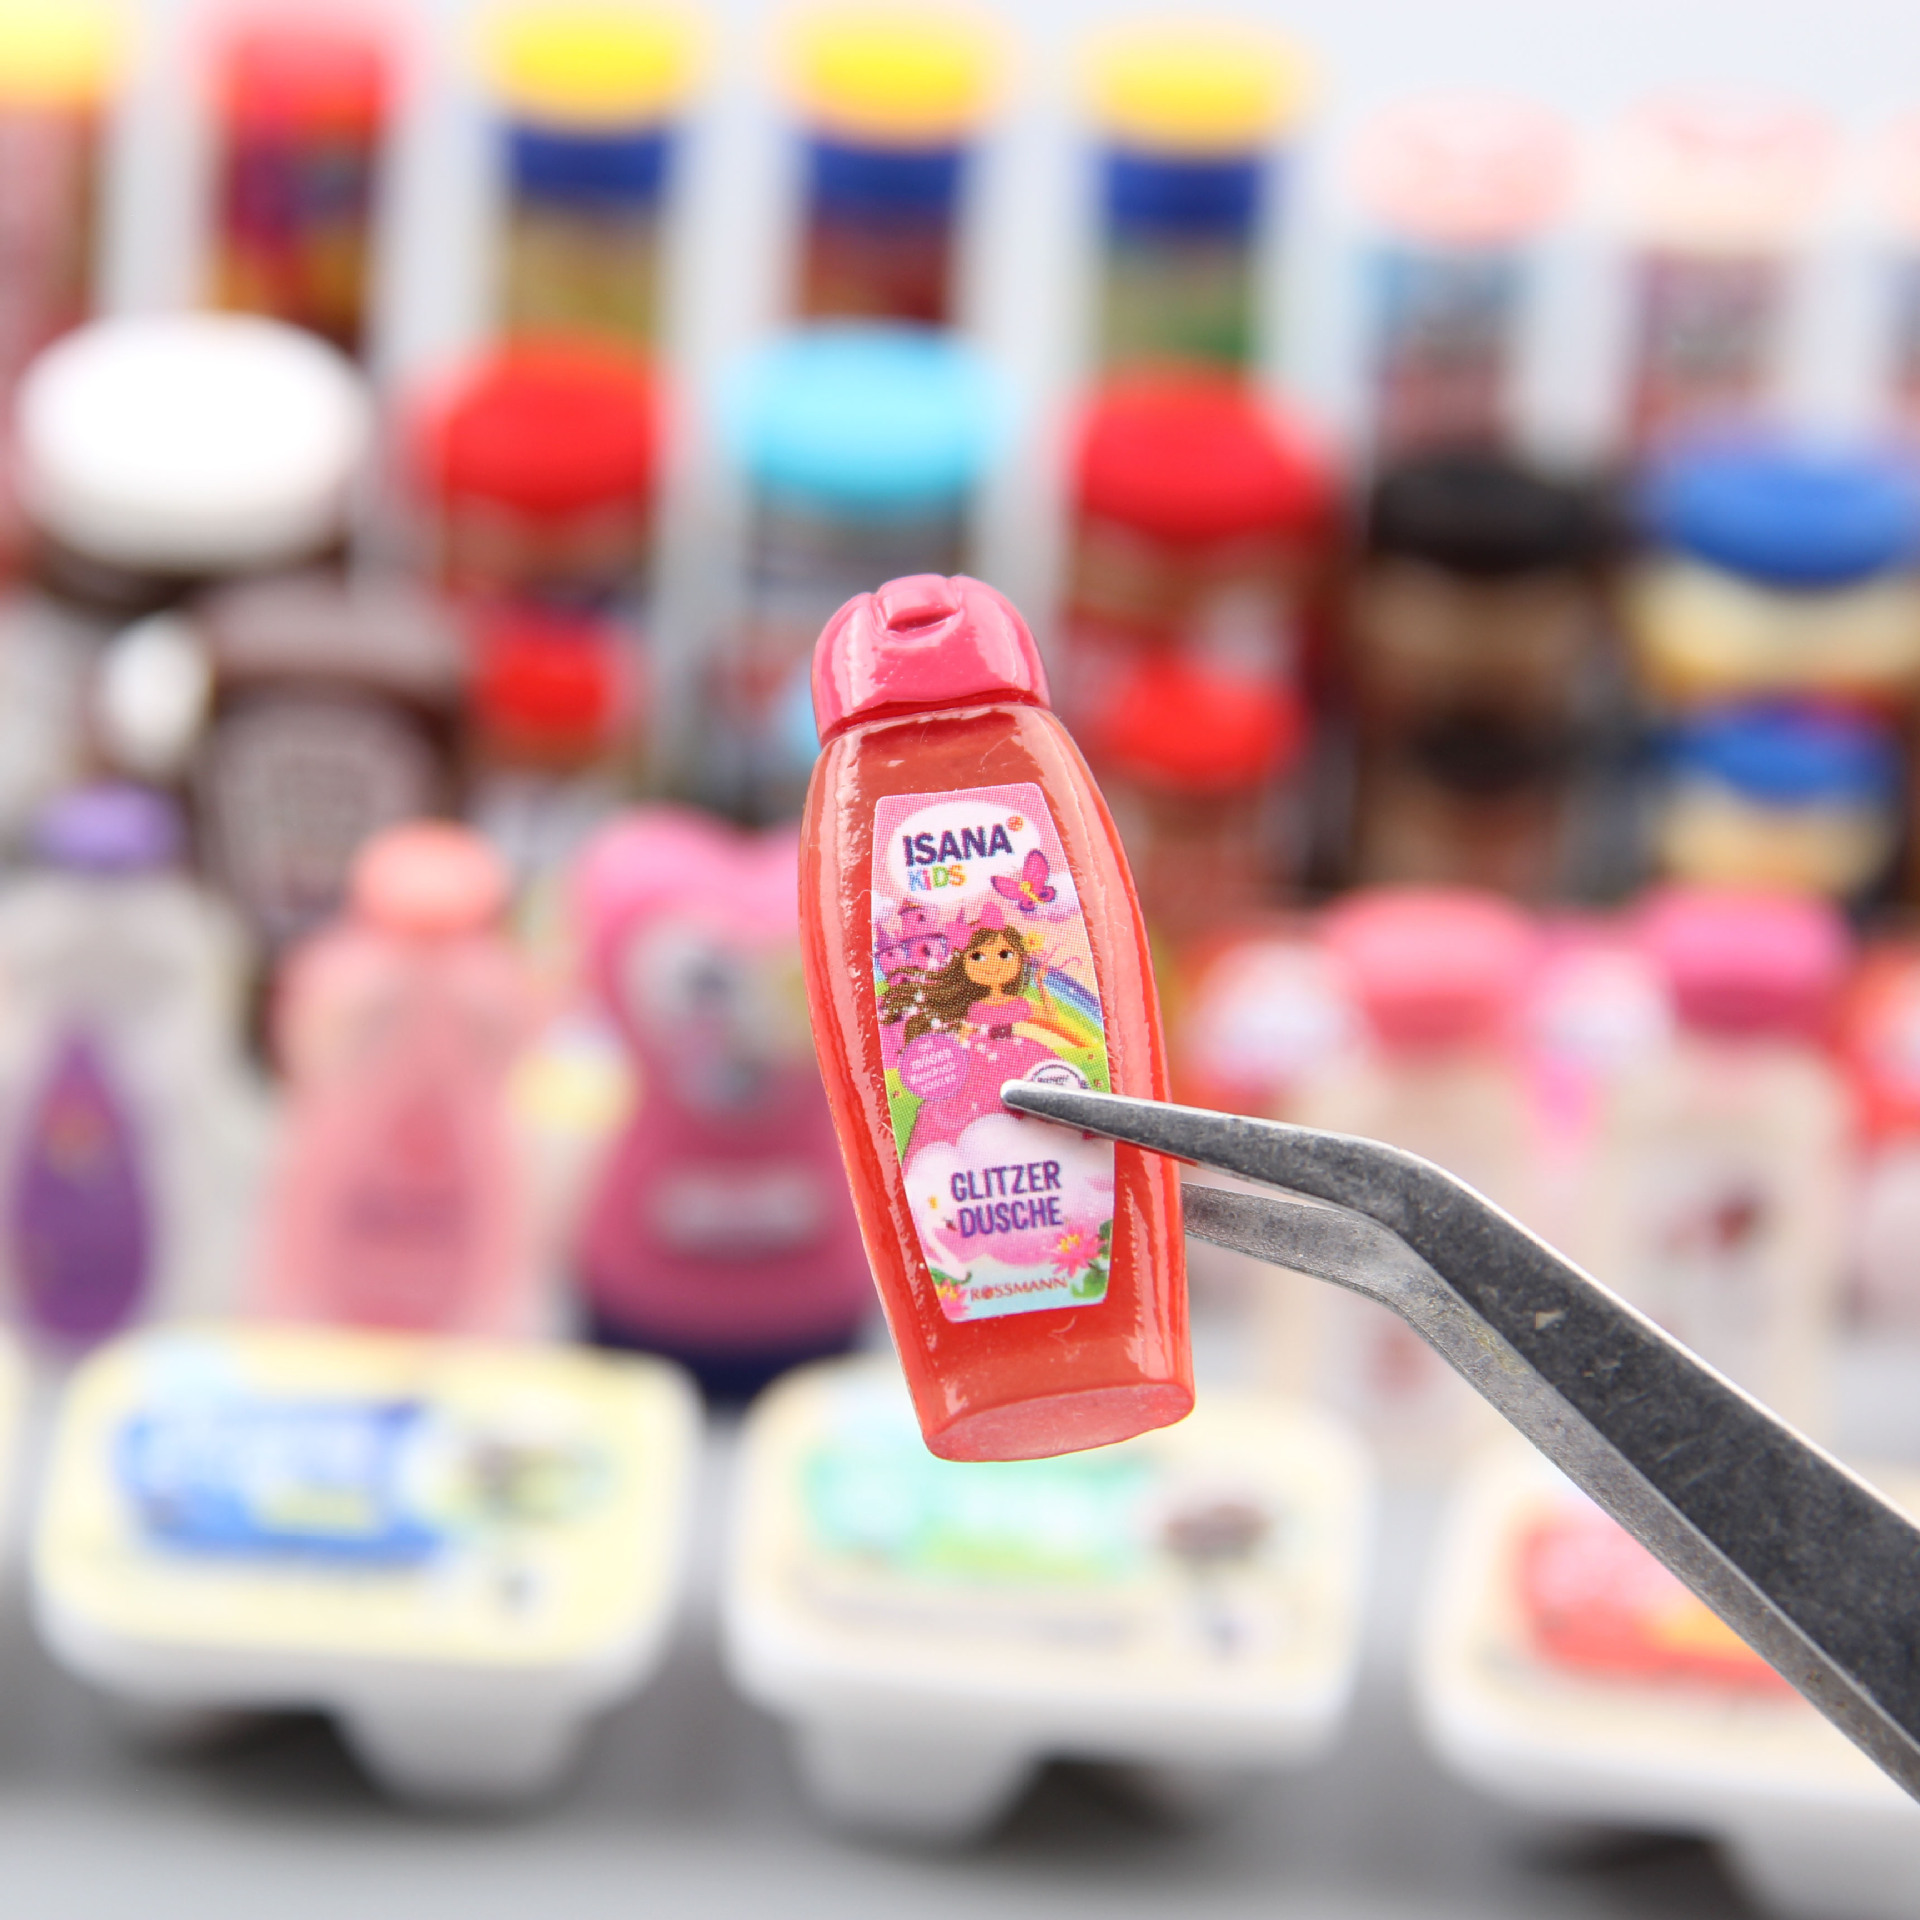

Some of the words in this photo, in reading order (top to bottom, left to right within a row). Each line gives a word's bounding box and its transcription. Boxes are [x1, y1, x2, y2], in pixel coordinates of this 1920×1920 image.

[904, 823, 1013, 867] ISANA
[951, 1160, 1061, 1202] GLITZER
[958, 1197, 1064, 1239] DUSCHE
[970, 1276, 1067, 1302] ROSSMANN
